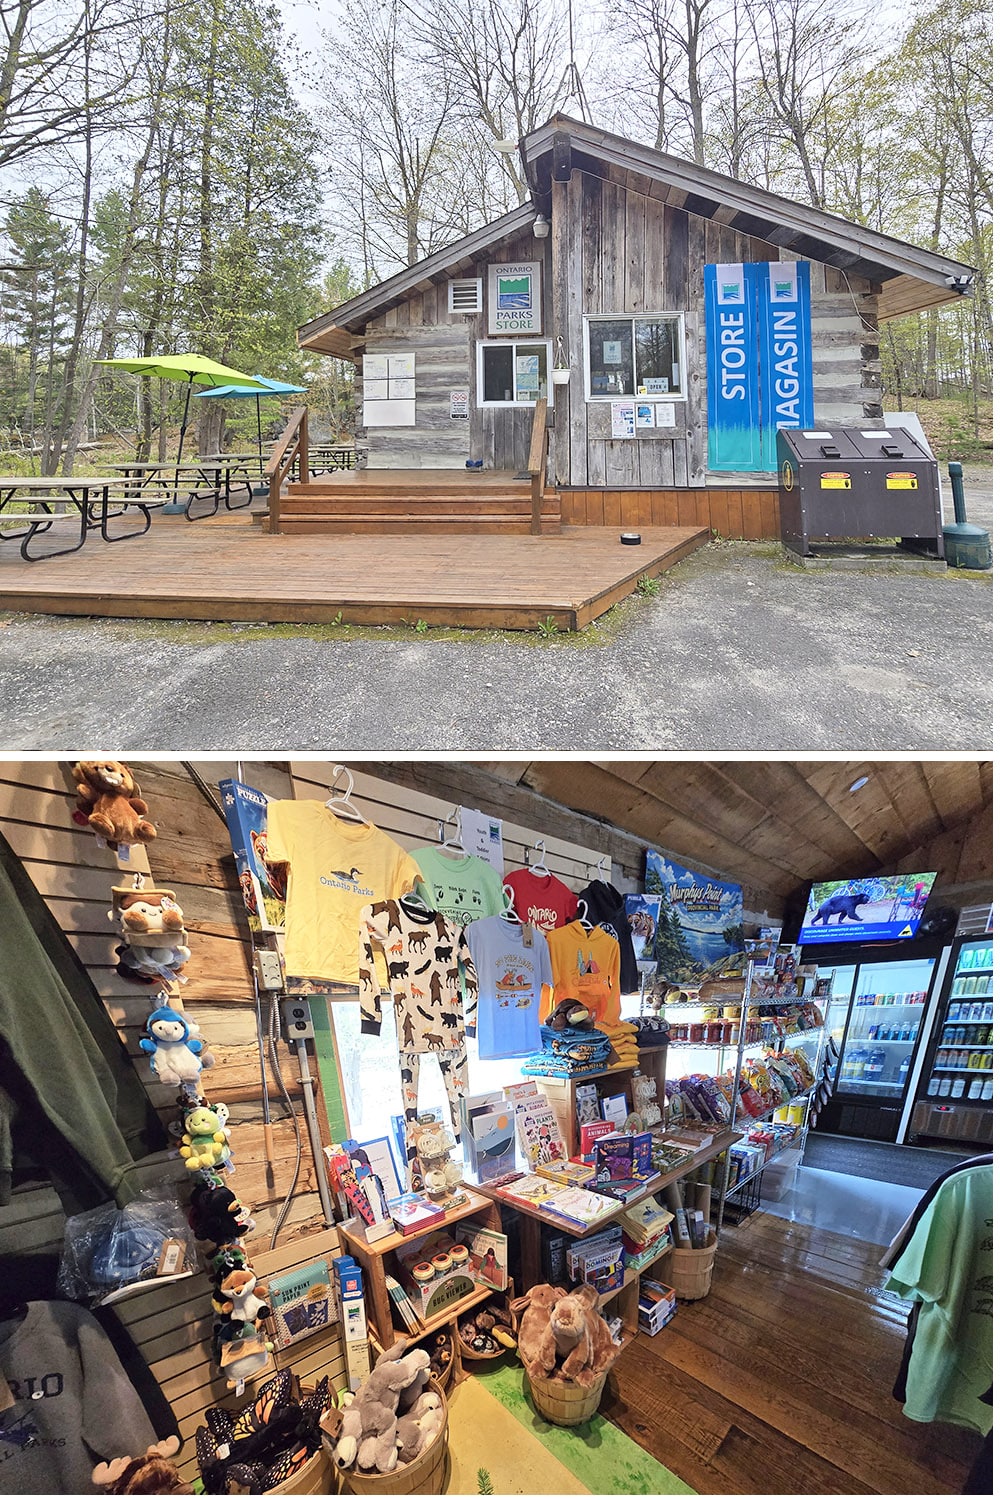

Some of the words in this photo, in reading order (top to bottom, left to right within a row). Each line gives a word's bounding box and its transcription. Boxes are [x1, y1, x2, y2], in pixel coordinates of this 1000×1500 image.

[497, 311, 533, 320] PARKS
[496, 320, 533, 330] STORE
[720, 312, 746, 400] STORE
[773, 311, 800, 430] AGASIN
[320, 876, 350, 890] Ontario
[353, 883, 374, 896] Parks
[669, 882, 703, 904] Murphys
[702, 883, 724, 901] Point
[536, 1116, 554, 1124] PLANTS
[586, 1128, 612, 1137] ANIMALS
[604, 1141, 630, 1150] Dreaming
[281, 1288, 293, 1299] SUN
[294, 1281, 311, 1295] PRINT
[283, 1291, 301, 1304] PAPER
[433, 1295, 446, 1307] BUG
[446, 1282, 468, 1300] VIEWER
